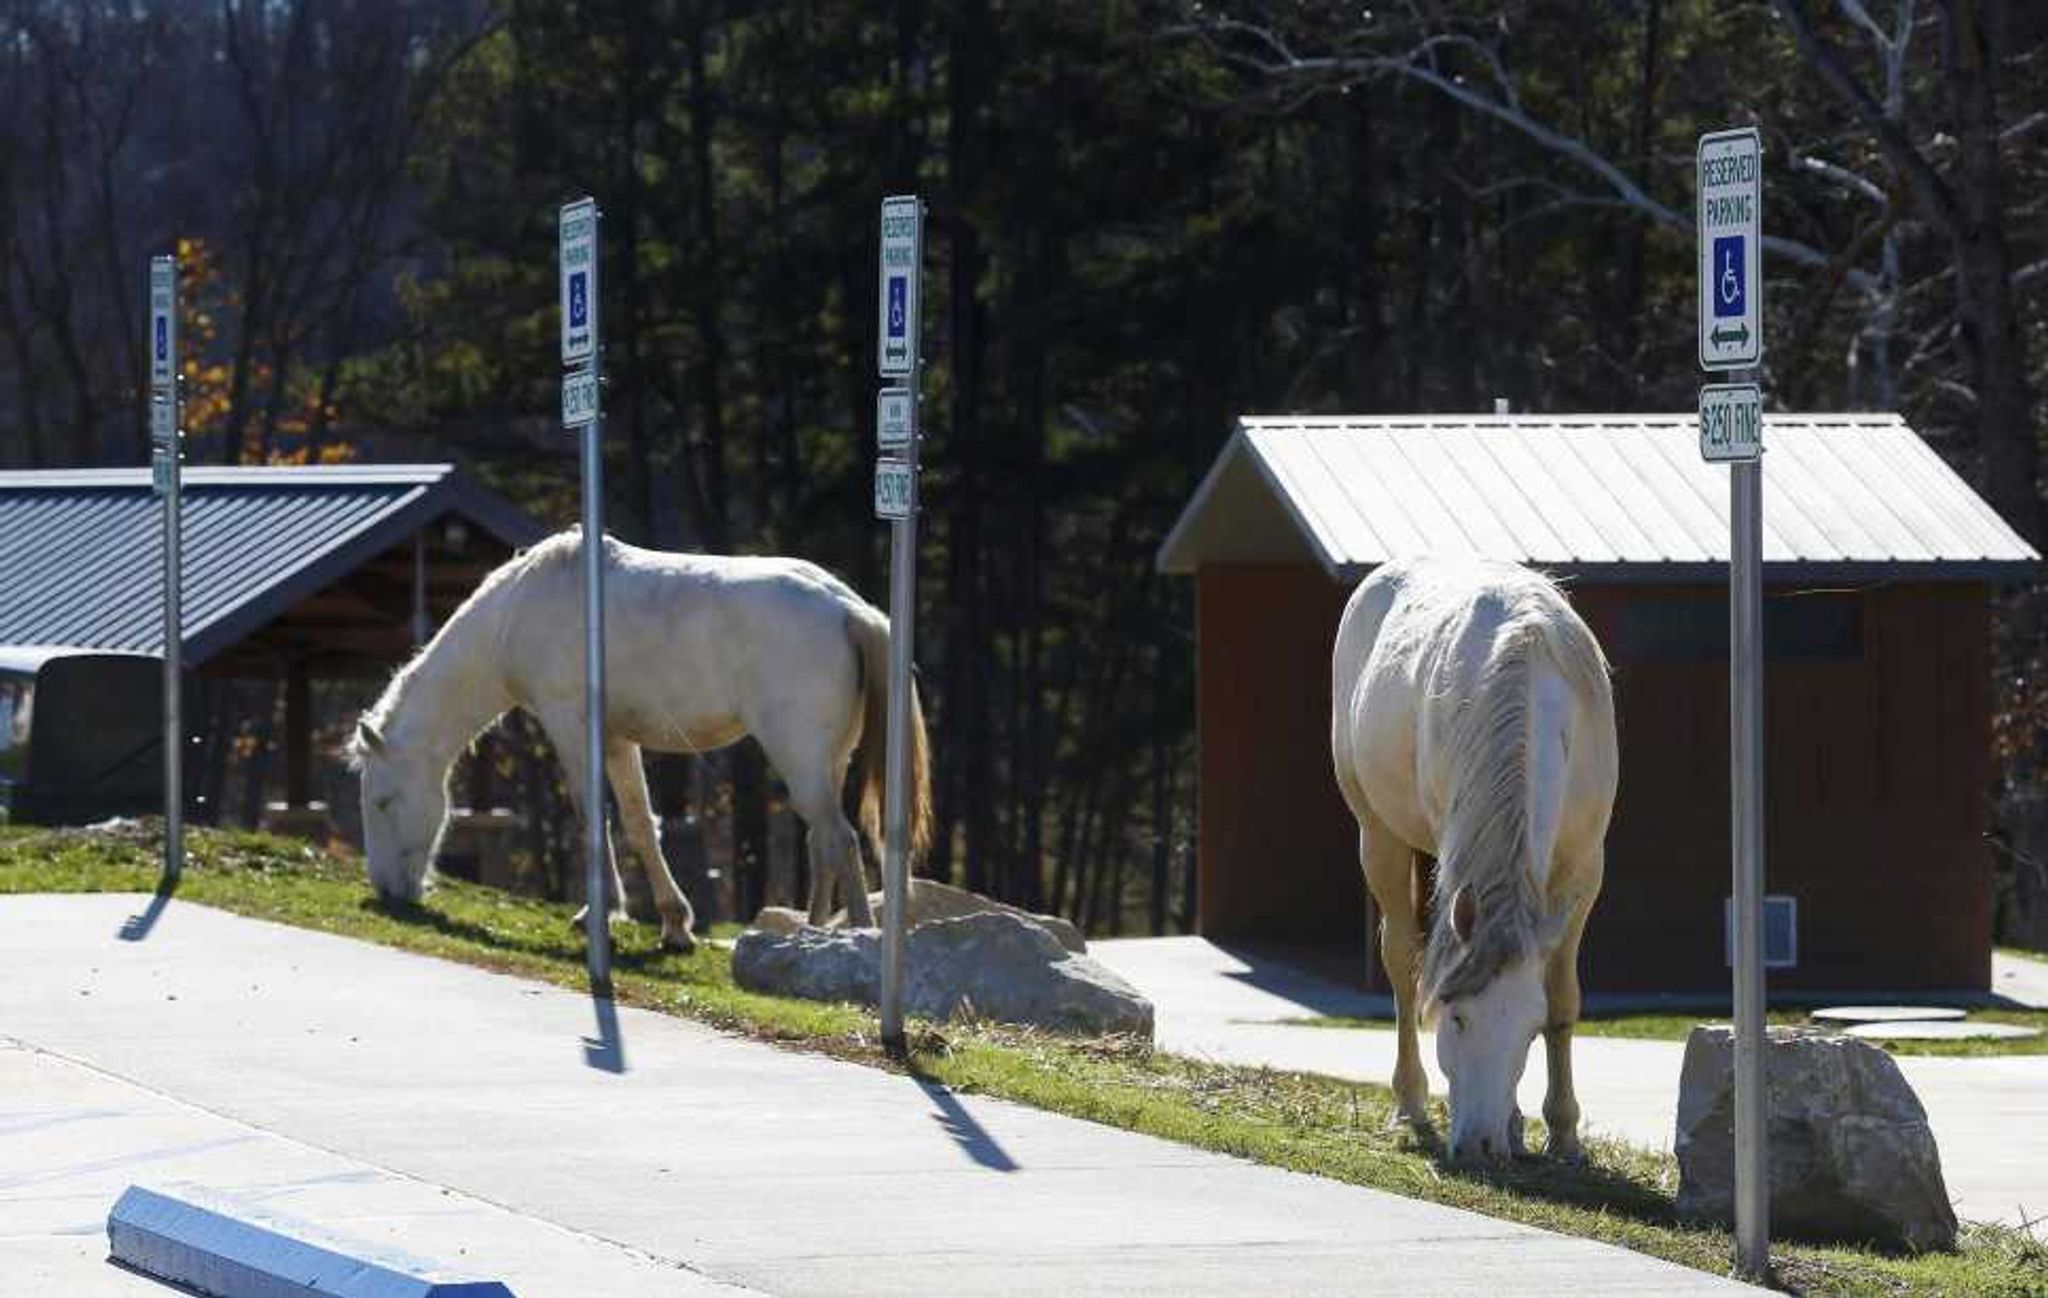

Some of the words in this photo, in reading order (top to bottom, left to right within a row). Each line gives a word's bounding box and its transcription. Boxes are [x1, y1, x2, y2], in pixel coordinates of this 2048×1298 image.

[1703, 155, 1754, 187] RESERVED
[1707, 195, 1752, 226] PARKING
[1703, 403, 1731, 444] $250
[1735, 402, 1759, 443] FINE
